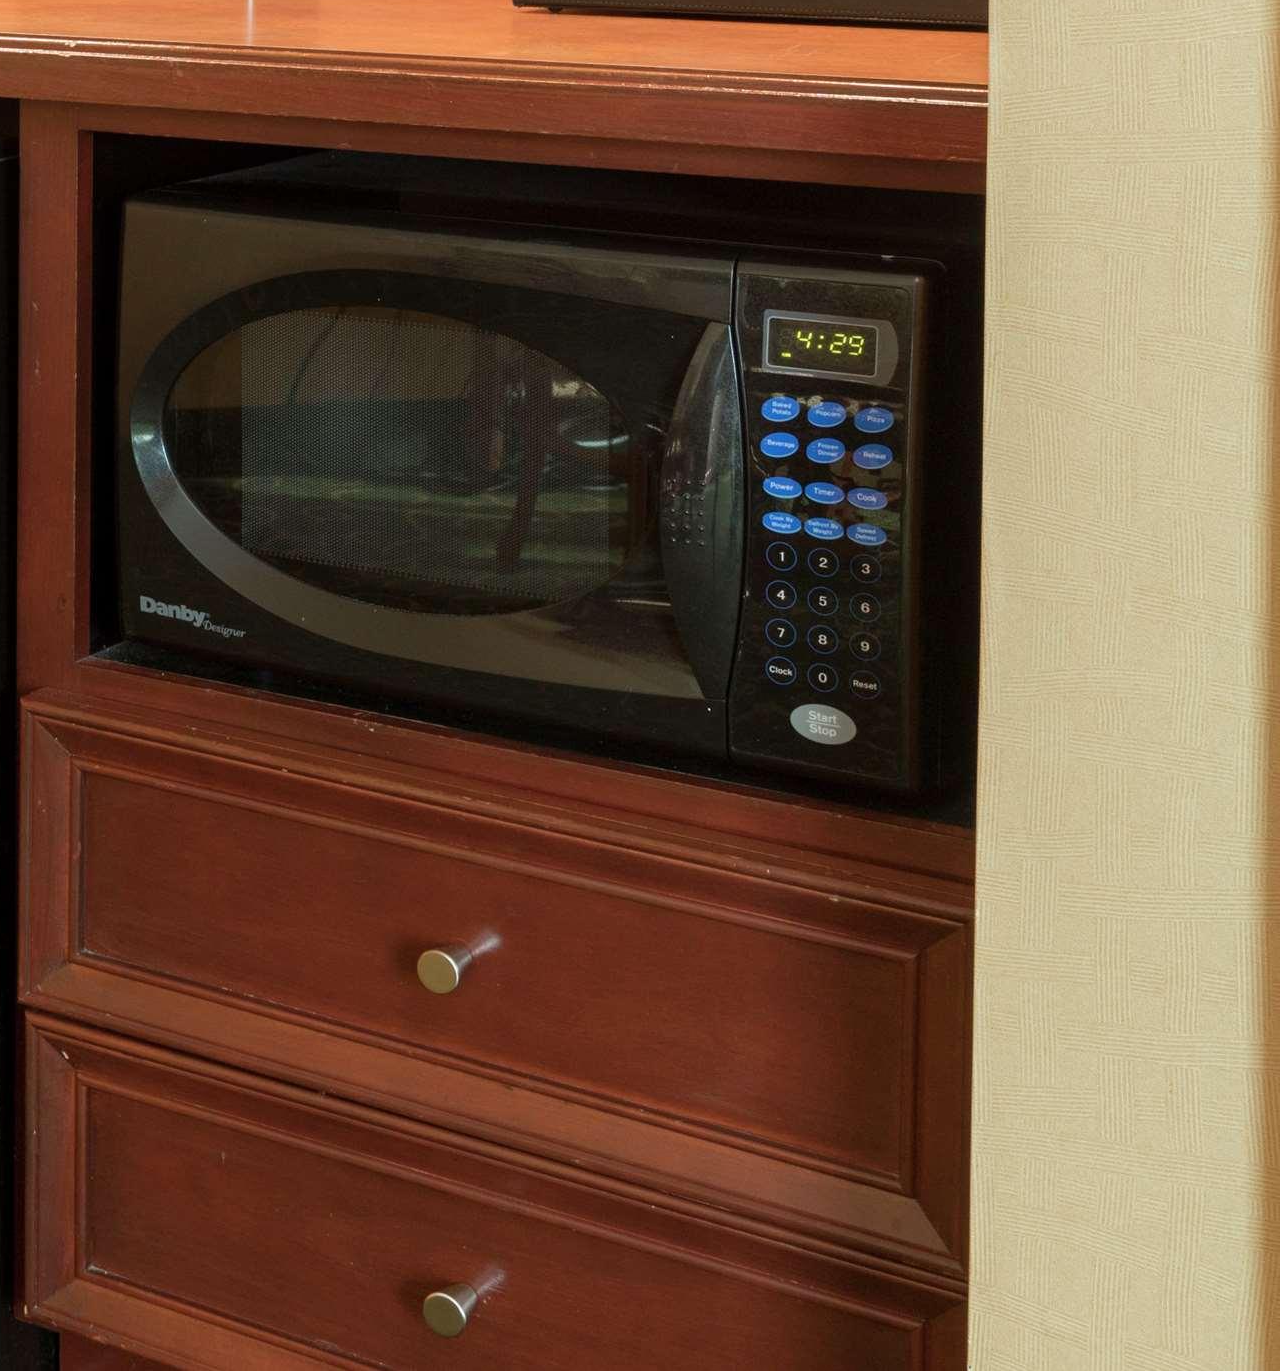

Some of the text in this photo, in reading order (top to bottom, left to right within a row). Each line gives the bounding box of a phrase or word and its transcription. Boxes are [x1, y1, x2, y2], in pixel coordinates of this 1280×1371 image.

[796, 330, 865, 356] 4:29
[770, 481, 794, 491] Power
[814, 486, 835, 496] Timer
[856, 492, 877, 503] Cook
[779, 551, 785, 562] 1
[819, 557, 828, 568] 2
[861, 563, 871, 574] 3
[777, 590, 786, 600] 4
[819, 595, 828, 606] 5
[861, 602, 871, 613] 6
[140, 595, 246, 637] Danby Designer
[777, 627, 785, 637] 7
[818, 634, 828, 645] 8
[861, 641, 870, 651] 9
[769, 665, 793, 676] Clock
[818, 672, 828, 683] 0
[853, 679, 878, 690] Reset
[808, 710, 837, 724] Start
[809, 723, 837, 737] Stop
